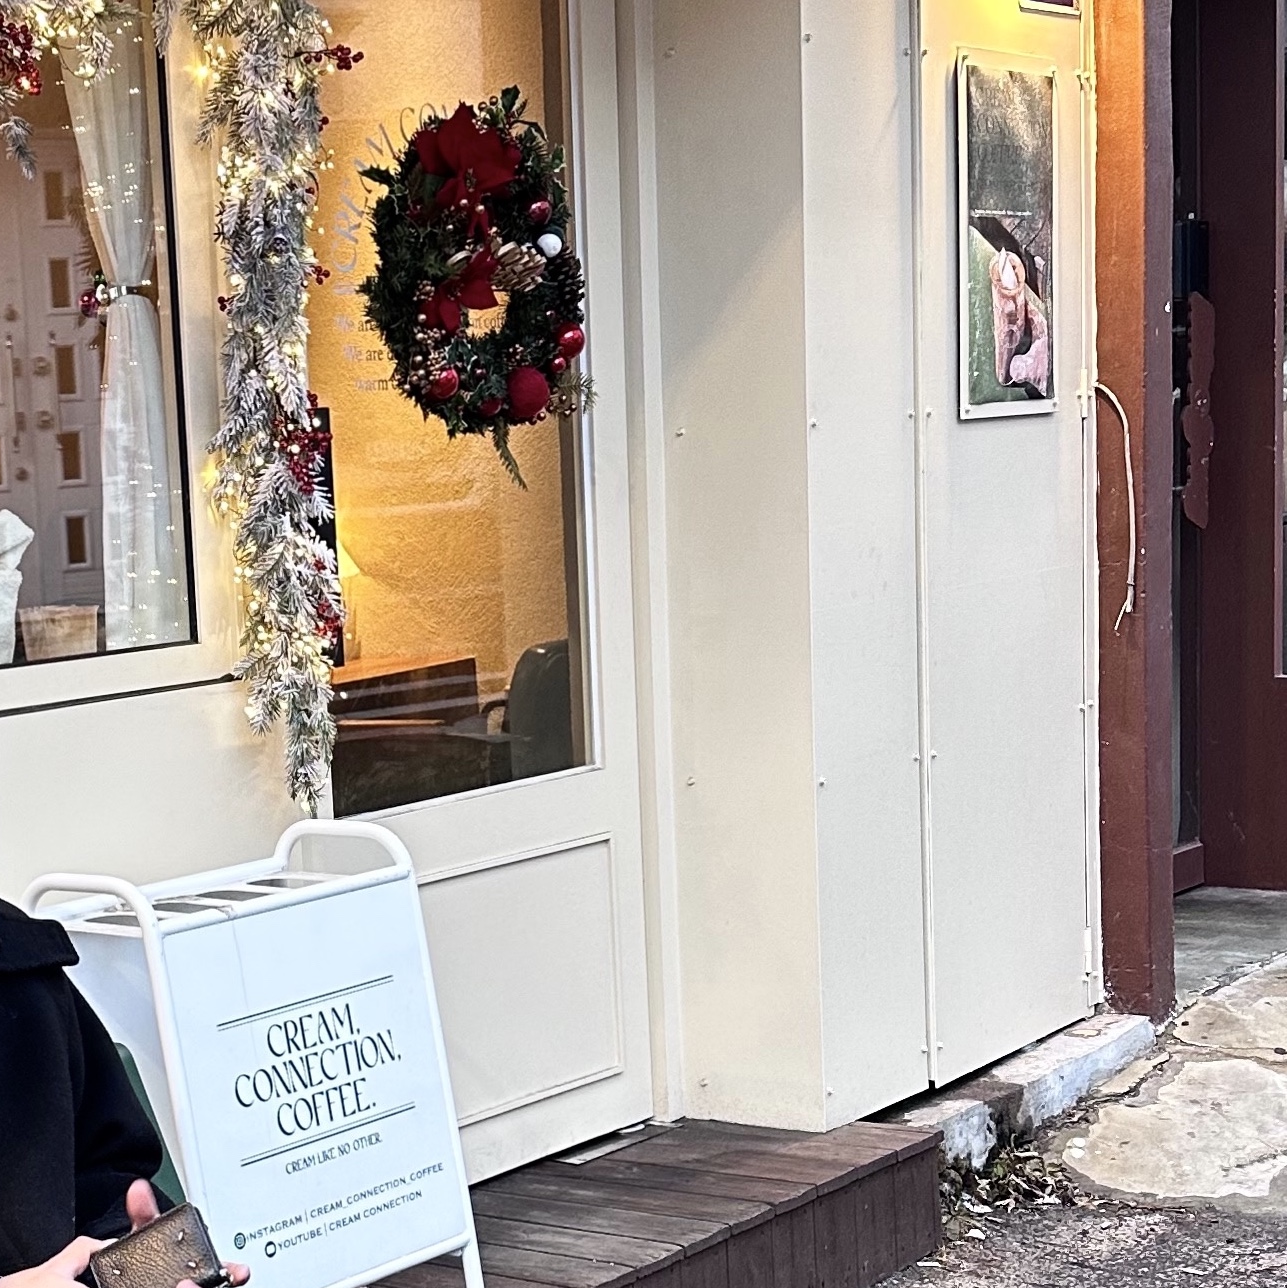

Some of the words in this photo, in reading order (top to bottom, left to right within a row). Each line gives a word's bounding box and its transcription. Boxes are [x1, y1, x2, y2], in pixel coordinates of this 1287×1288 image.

[365, 349, 384, 361] are
[267, 1003, 360, 1057] CREAM,
[235, 1029, 402, 1108] CONNECTION,
[277, 1078, 377, 1136] COFFEE.
[285, 1154, 317, 1175] CREAM
[317, 1147, 337, 1164] LIKE
[337, 1142, 351, 1157] NO
[246, 1215, 303, 1242] INSTAGRAM
[310, 1162, 444, 1218] CREAM_CONNECTION_COFFEE
[277, 1227, 323, 1251] YOUTUBE
[329, 1212, 361, 1231] CREAM
[363, 1189, 423, 1218] CONNECTION
